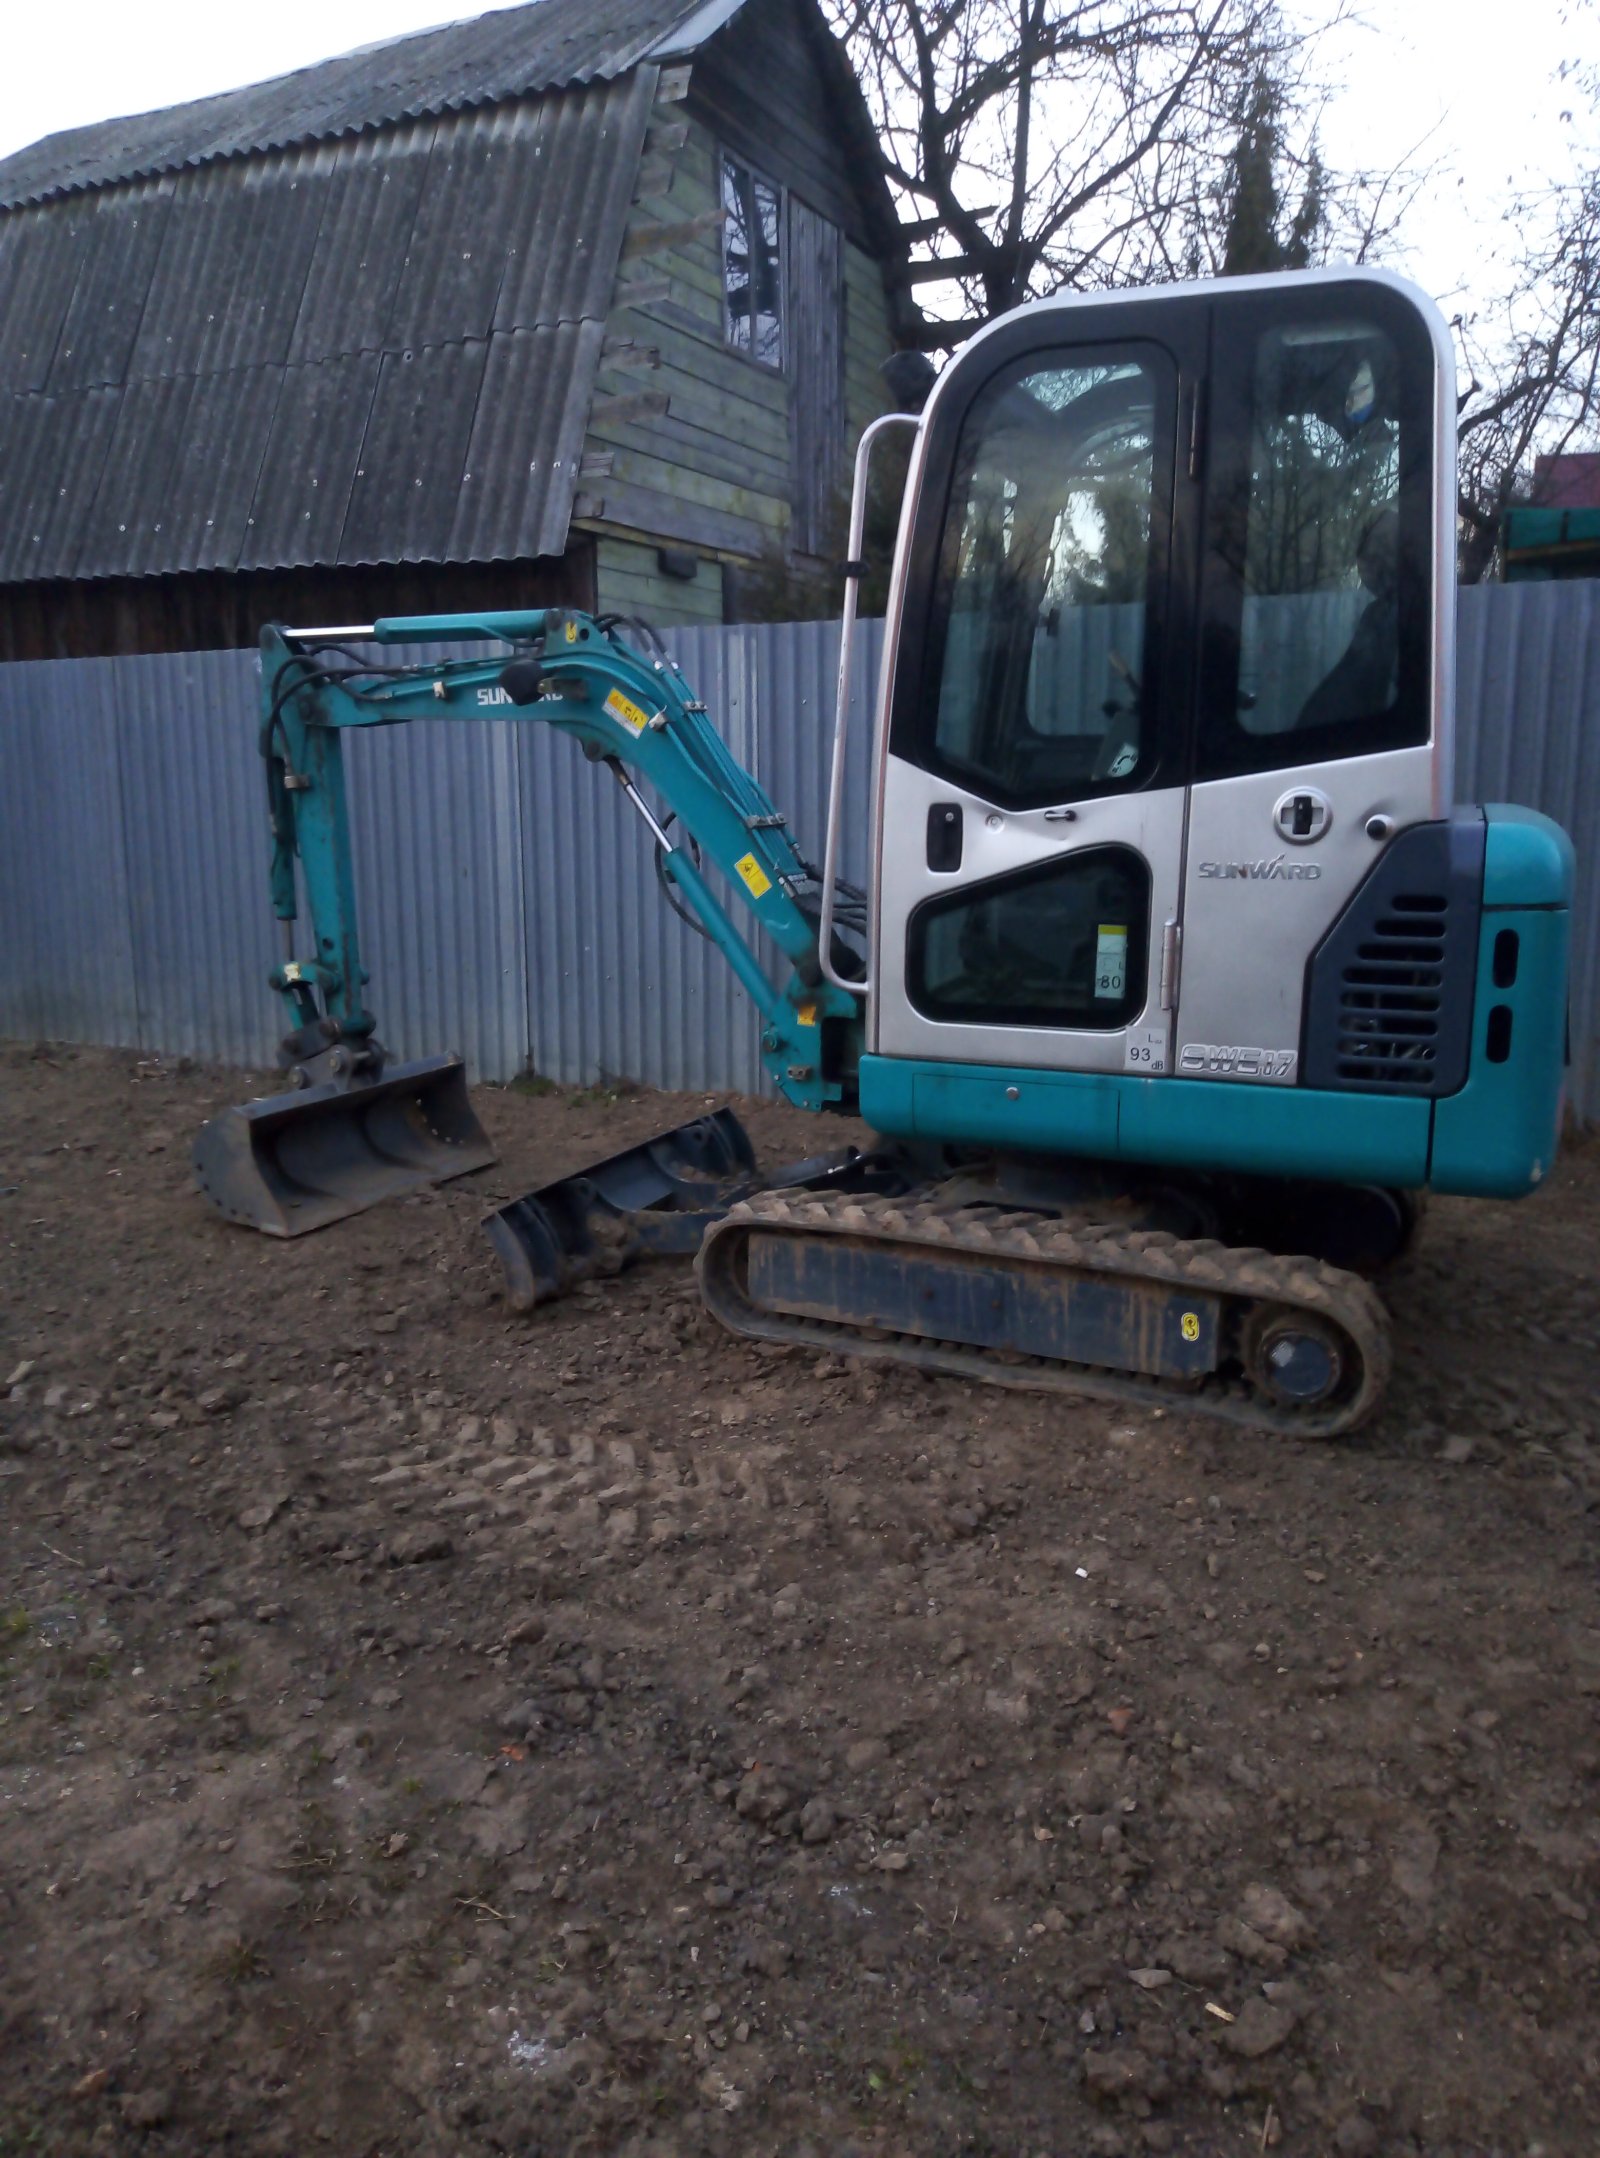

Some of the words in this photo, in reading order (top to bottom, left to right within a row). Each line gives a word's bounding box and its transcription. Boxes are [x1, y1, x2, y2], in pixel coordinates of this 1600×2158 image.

[1199, 853, 1321, 880] SUNWARD
[1130, 1047, 1150, 1061] 93
[1180, 1044, 1298, 1077] SWE17
[1151, 1060, 1164, 1070] dB
